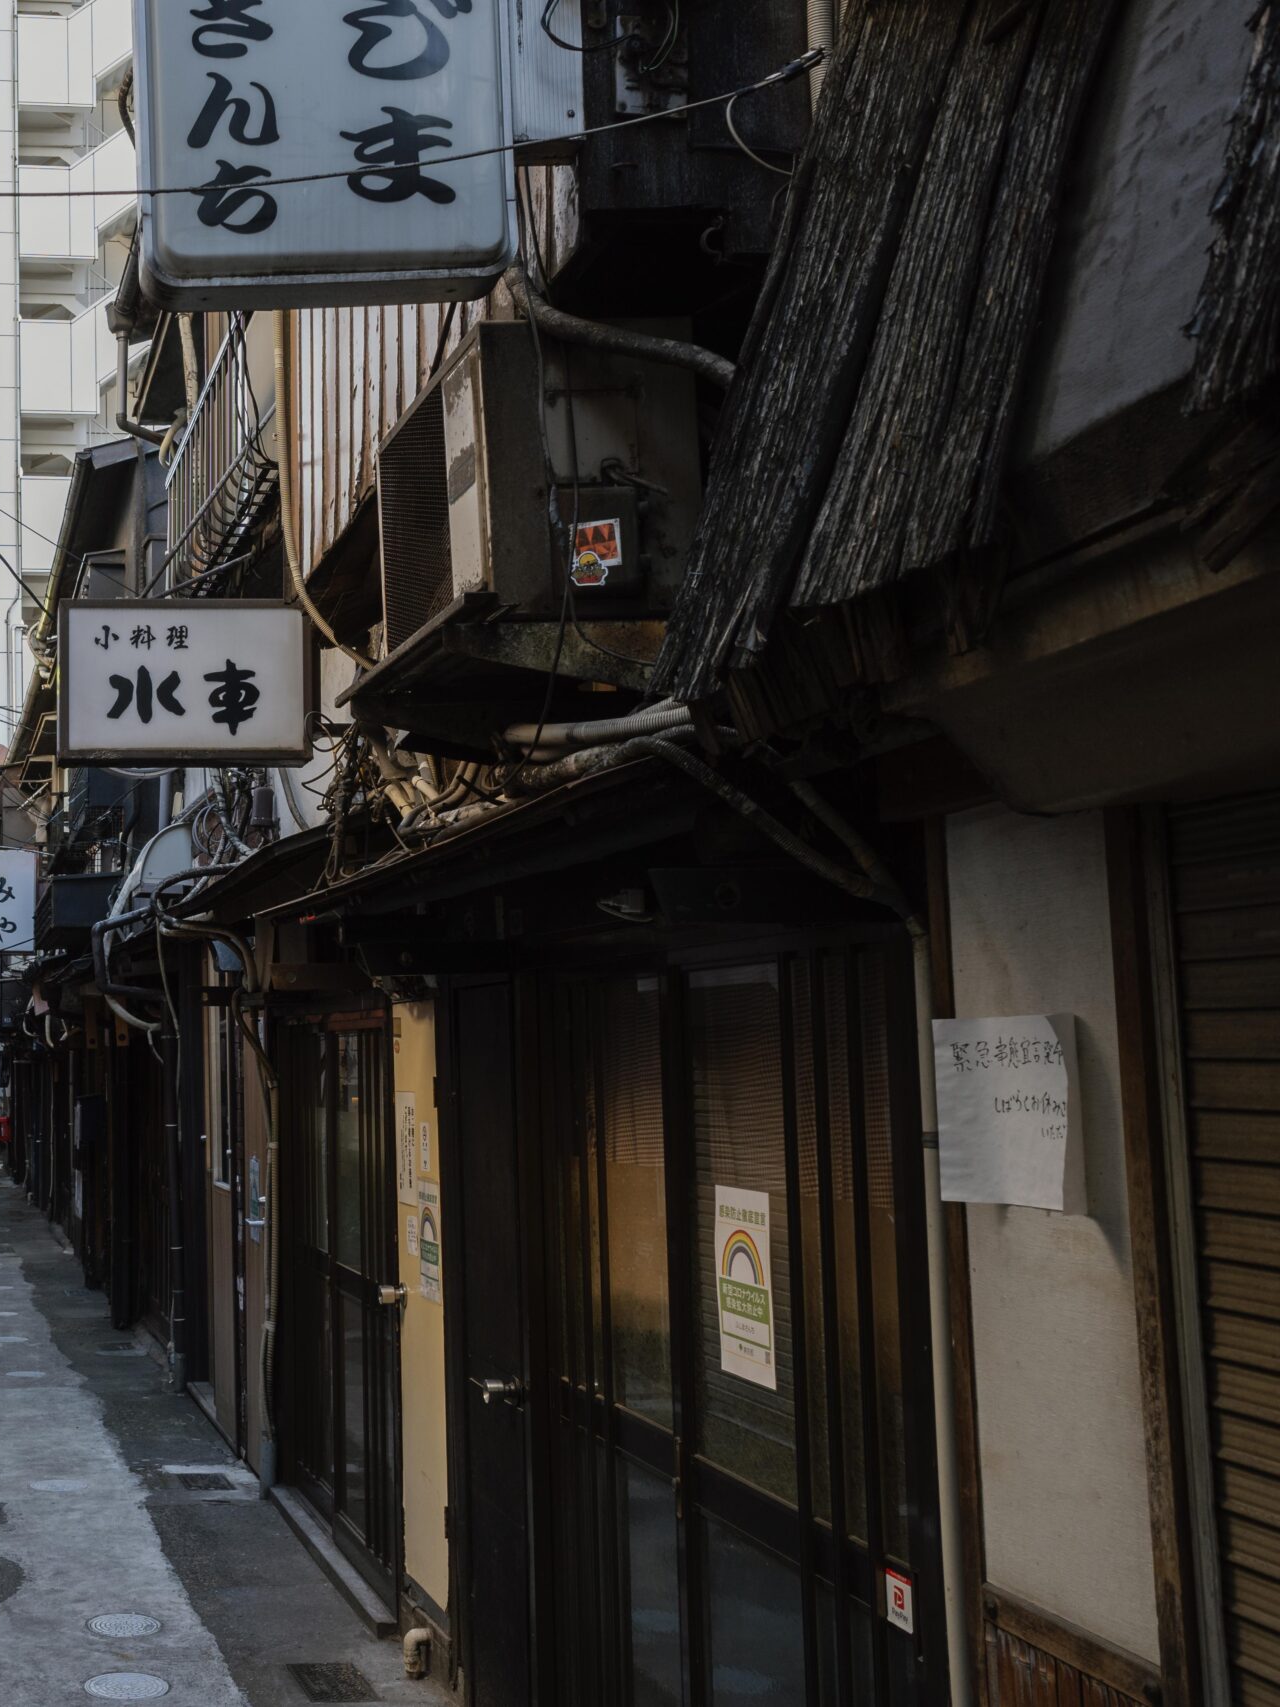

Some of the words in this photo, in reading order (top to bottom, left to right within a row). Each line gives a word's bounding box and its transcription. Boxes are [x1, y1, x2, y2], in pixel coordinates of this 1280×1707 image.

[93, 623, 190, 651] 小料理
[106, 657, 261, 736] 水車
[722, 1282, 766, 1305] 新型コロナウイルス
